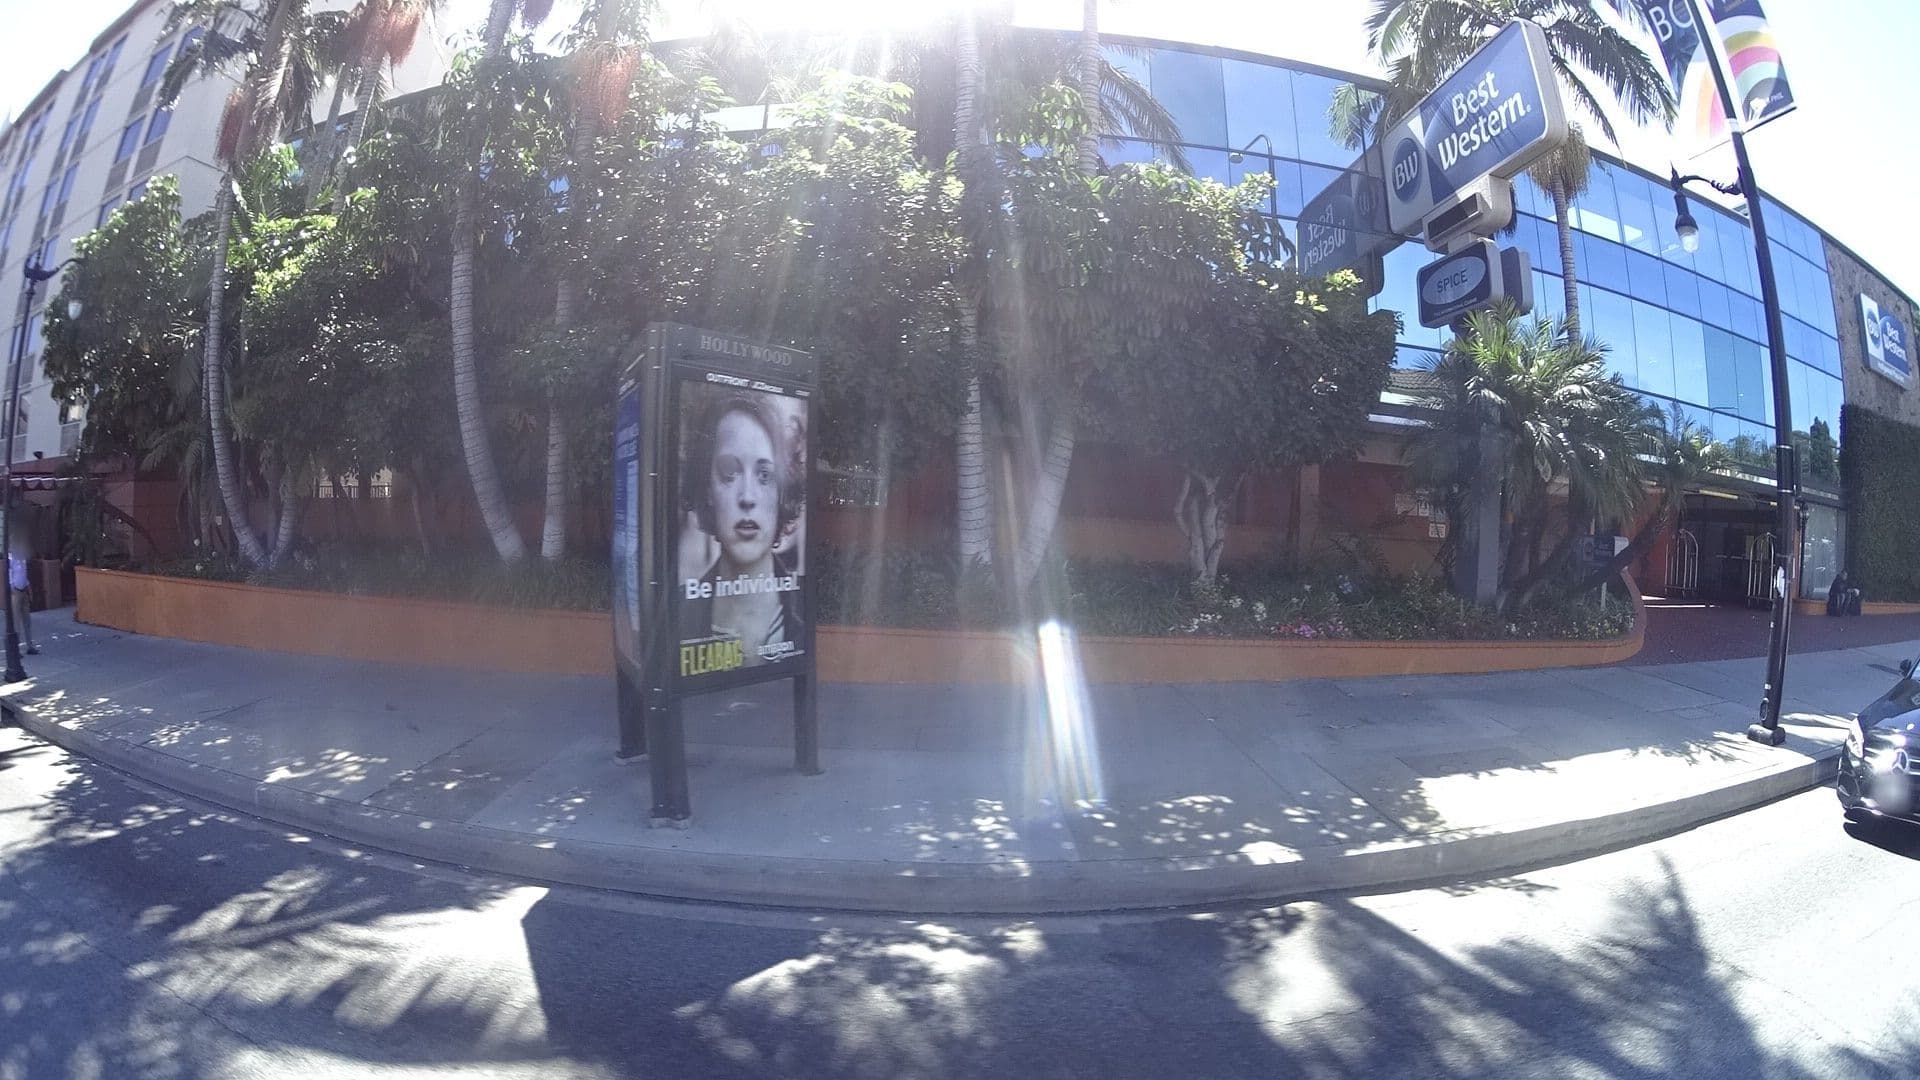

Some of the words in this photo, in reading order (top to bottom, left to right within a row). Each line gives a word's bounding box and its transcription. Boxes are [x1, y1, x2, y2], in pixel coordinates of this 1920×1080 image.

[1451, 71, 1499, 126] Best
[1395, 151, 1418, 190] BW
[1436, 269, 1468, 293] SPICE
[700, 335, 792, 366] HOLLYWOOD
[685, 578, 712, 599] Be
[680, 639, 743, 676] FLEABAG
